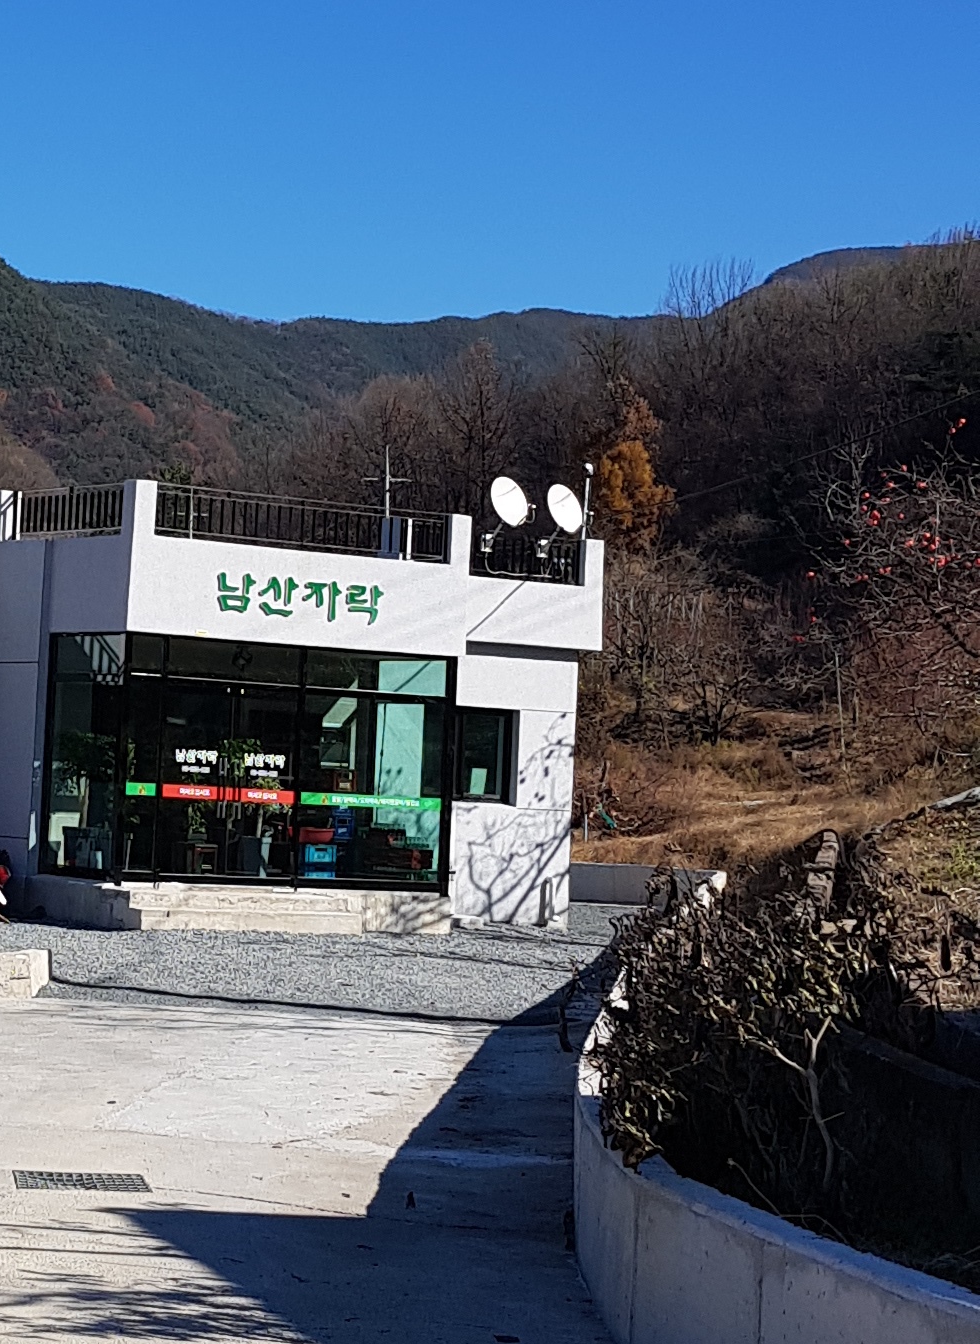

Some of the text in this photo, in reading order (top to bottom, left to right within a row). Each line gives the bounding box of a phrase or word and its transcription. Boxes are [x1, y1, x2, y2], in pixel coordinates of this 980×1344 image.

[217, 572, 384, 625] 남산자락
[175, 748, 218, 765] 남산자락
[244, 752, 286, 769] 남산자락
